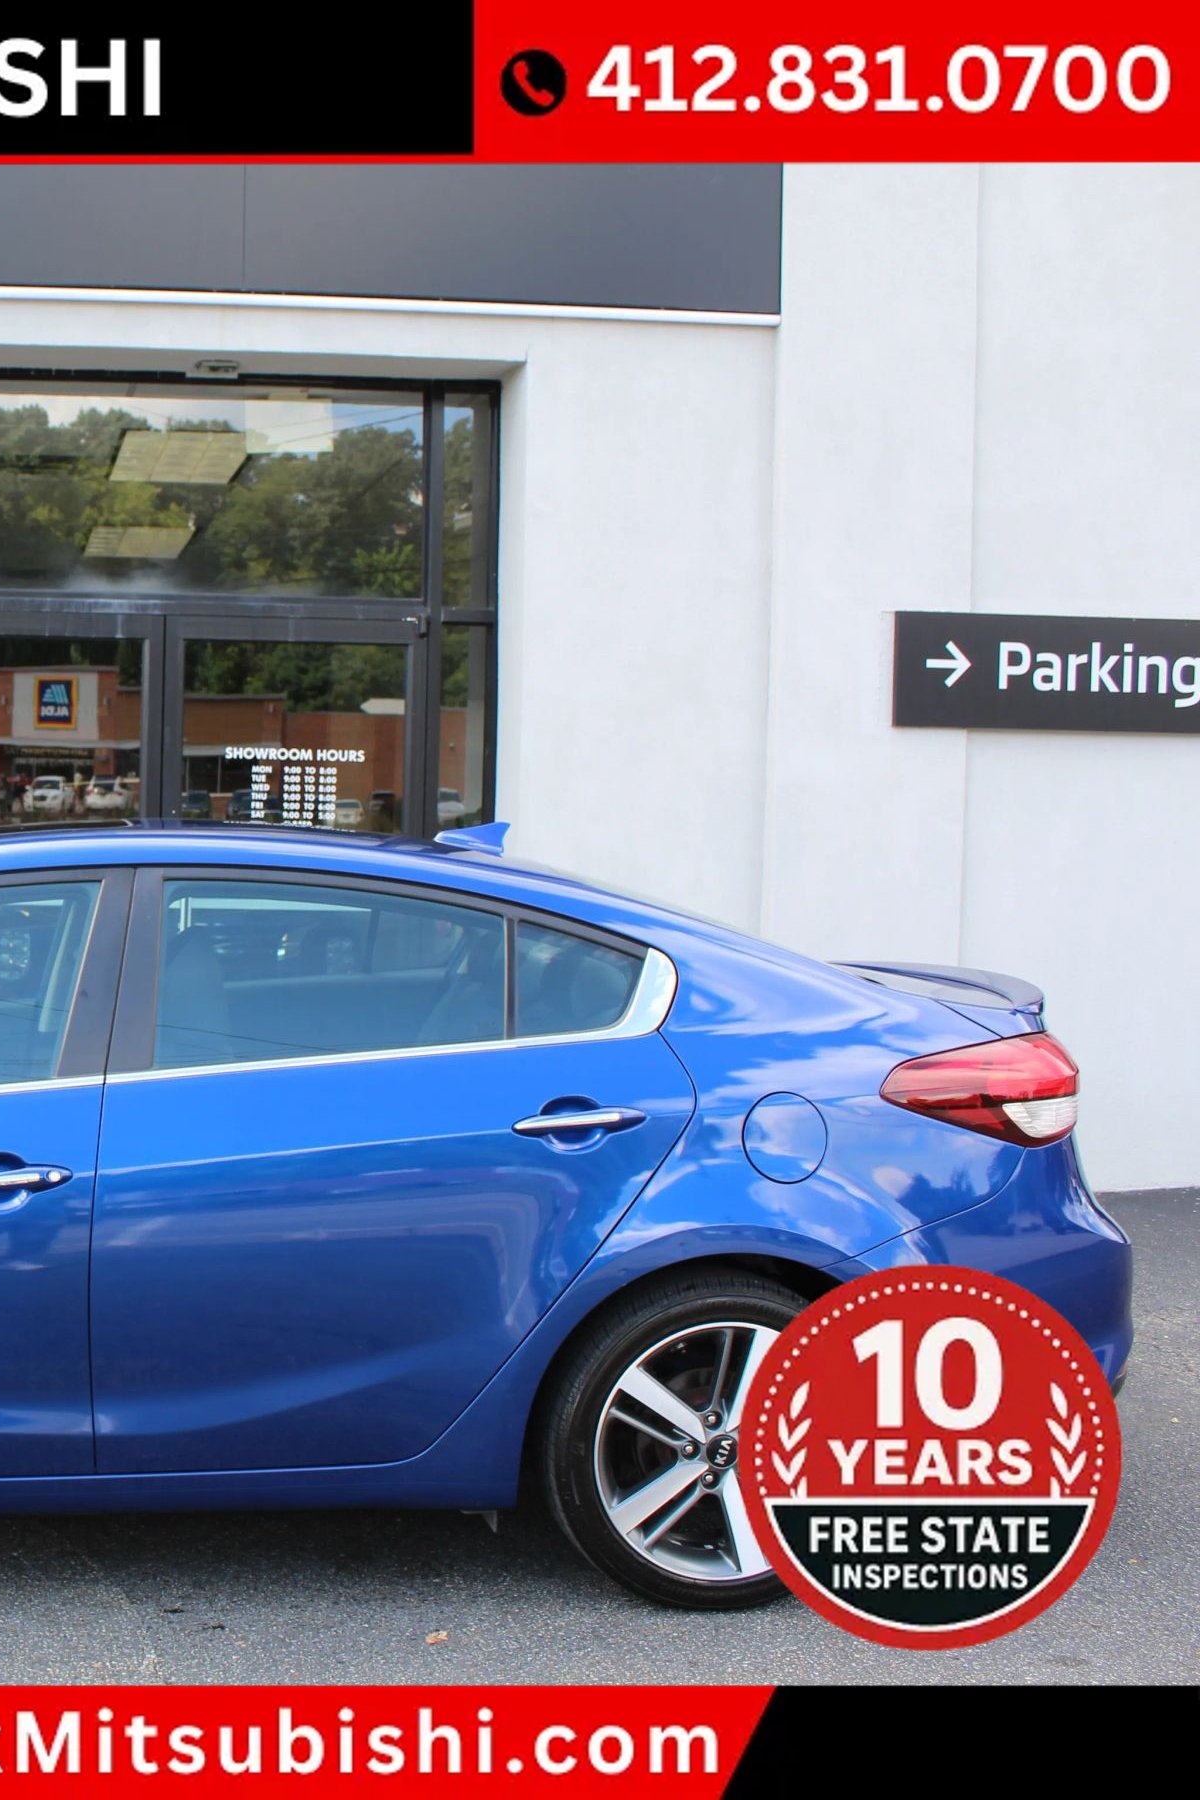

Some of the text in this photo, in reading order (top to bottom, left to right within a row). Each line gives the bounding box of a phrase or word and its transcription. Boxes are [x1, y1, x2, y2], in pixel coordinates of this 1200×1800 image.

[998, 641, 1200, 708] Parking
[225, 747, 365, 763] SHOWROOM HOURS
[251, 765, 273, 774] MON
[283, 766, 302, 774] 9:00
[304, 766, 316, 775] TO
[251, 774, 267, 783] TUE
[283, 775, 301, 783] 9:00
[304, 775, 316, 784] TO
[250, 783, 271, 792] WED
[282, 784, 301, 792] 9:00
[304, 784, 316, 793] TO
[250, 792, 268, 801] THU
[282, 793, 301, 801] 9:00
[304, 793, 316, 802] TO
[250, 801, 264, 810] FRI
[282, 802, 301, 810] 9:00
[303, 802, 315, 811] TO
[250, 810, 266, 819] SAT
[282, 811, 300, 819] 9:00
[302, 811, 314, 820] TO
[714, 1440, 733, 1465] KIA
